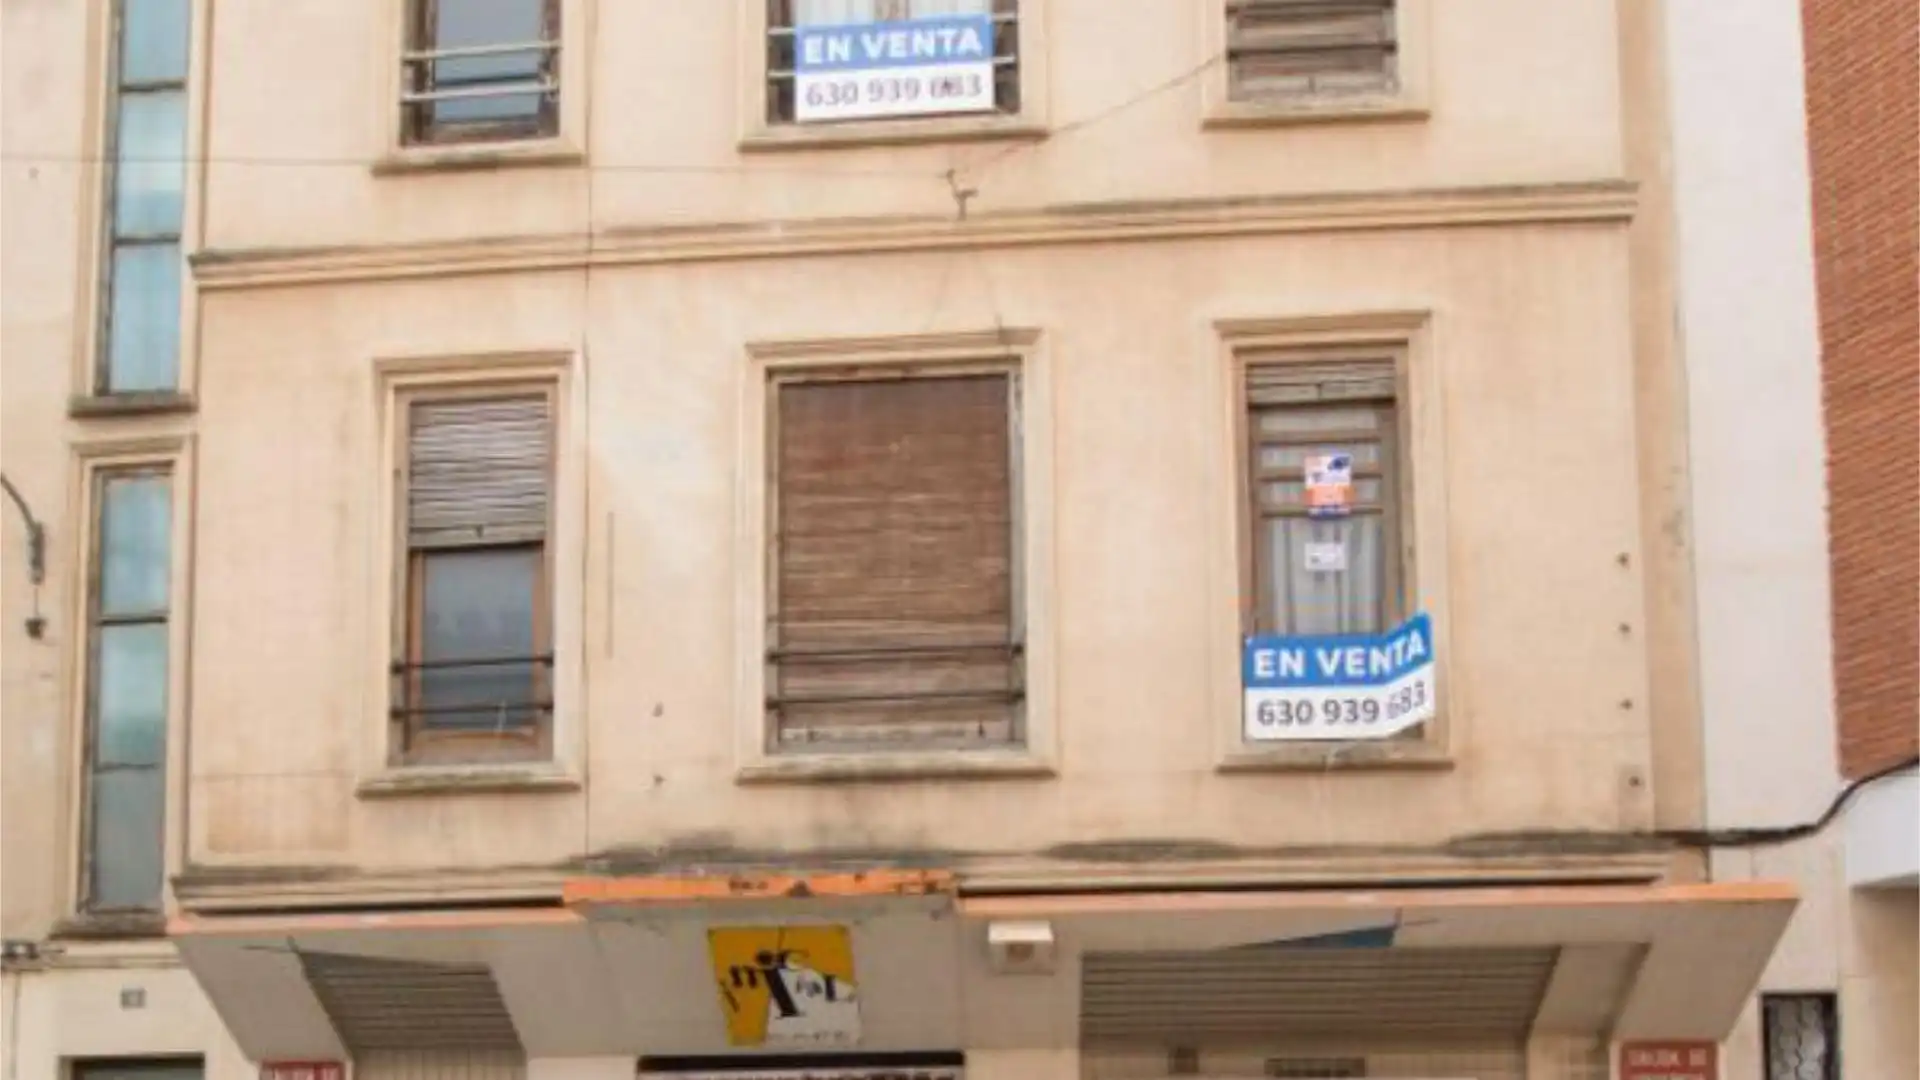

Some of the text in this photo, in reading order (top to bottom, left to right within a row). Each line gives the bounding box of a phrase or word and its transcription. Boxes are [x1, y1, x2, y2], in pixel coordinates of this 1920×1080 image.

[804, 27, 984, 64] EN VENTA
[806, 79, 860, 107] 630
[867, 76, 922, 104] 939
[1253, 628, 1427, 678] EN VENTA
[1257, 698, 1314, 726] 630
[1321, 698, 1381, 725] 939
